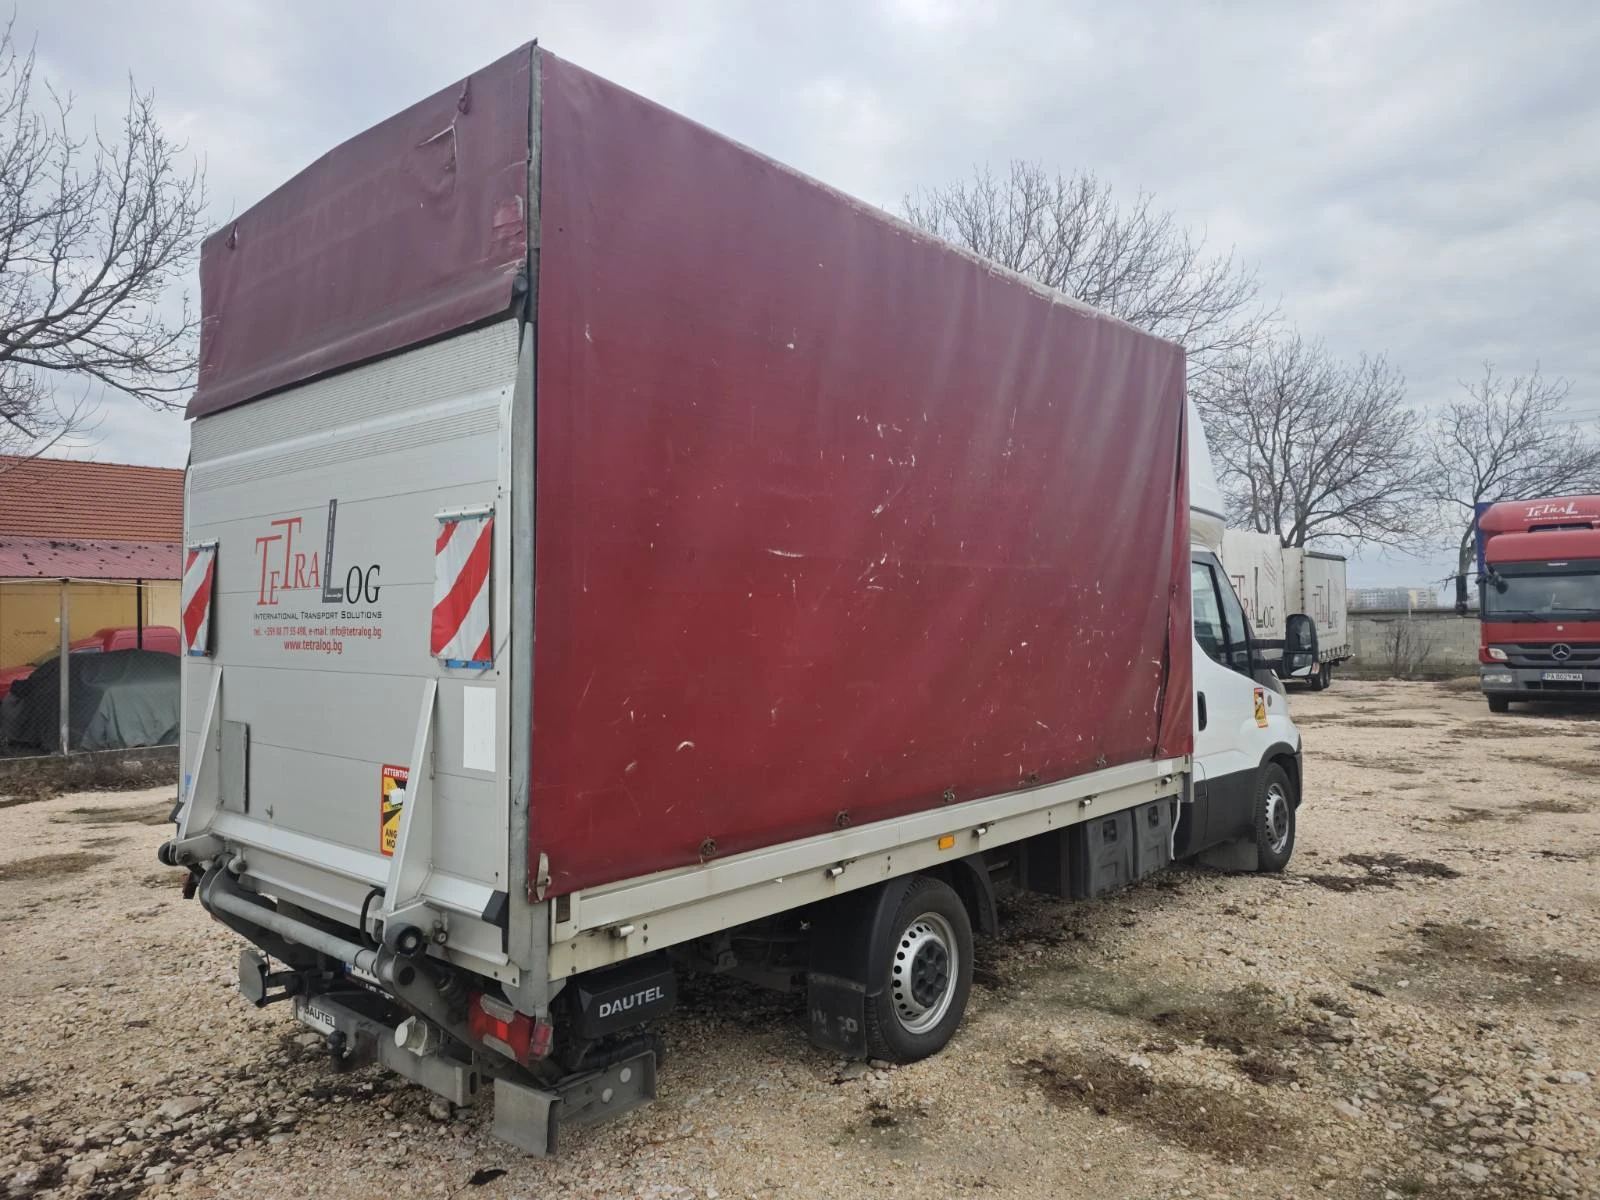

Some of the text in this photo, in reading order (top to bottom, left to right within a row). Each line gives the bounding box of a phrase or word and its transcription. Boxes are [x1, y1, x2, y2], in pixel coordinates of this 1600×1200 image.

[254, 610, 382, 621] INTERNATIONAL TRANSPORT SOLUTIONS
[330, 626, 382, 639] info@tetralog.bg
[284, 639, 343, 654] www.tetralog.bg
[599, 986, 665, 1018] DAUTEL
